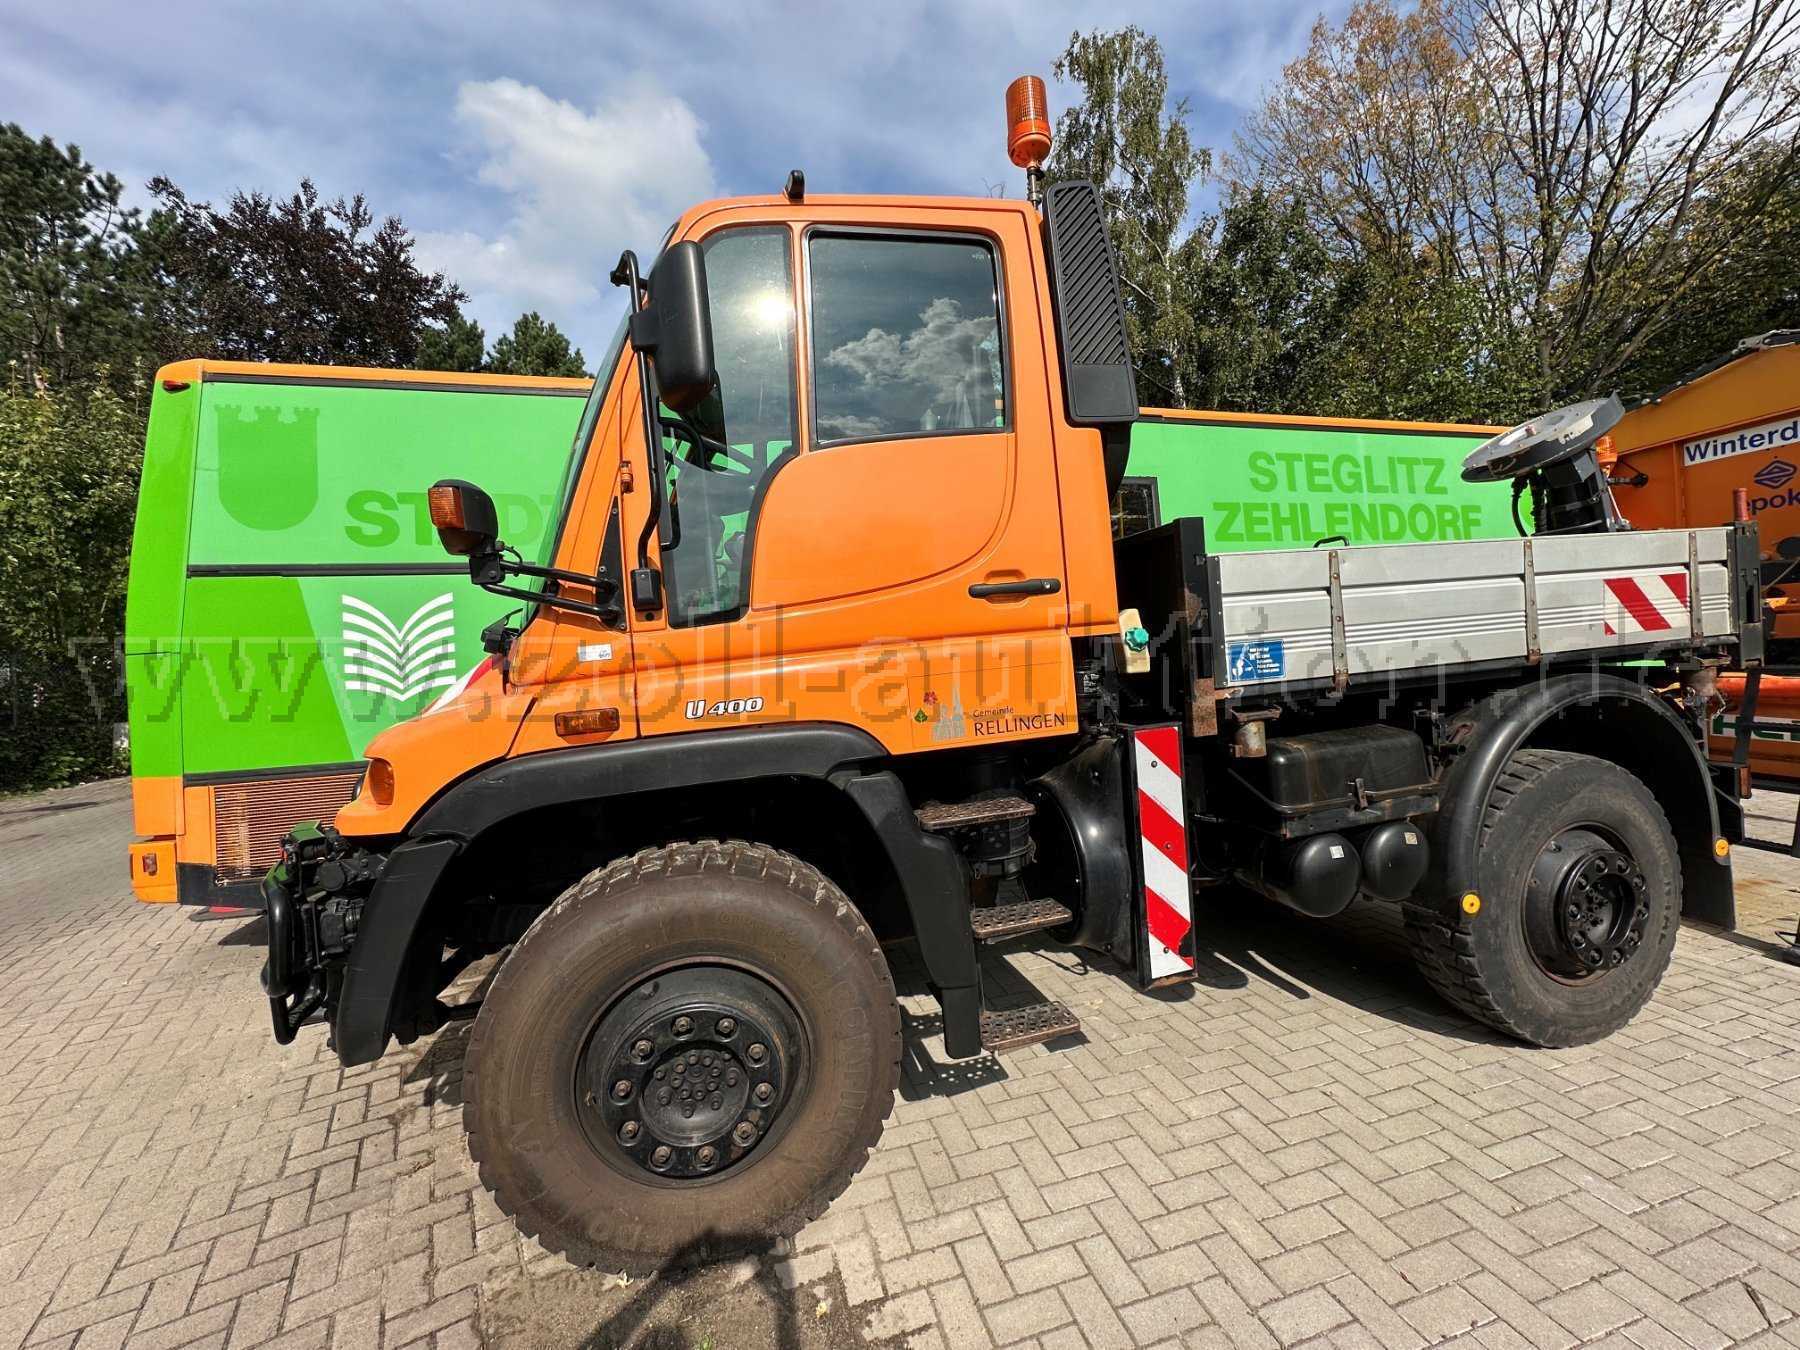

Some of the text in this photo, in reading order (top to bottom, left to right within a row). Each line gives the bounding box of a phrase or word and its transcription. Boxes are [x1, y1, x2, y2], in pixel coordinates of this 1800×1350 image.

[1685, 420, 1799, 462] Winterd
[1248, 451, 1448, 495] STEGLITZ
[1746, 488, 1800, 515] pok
[344, 489, 556, 548] STD
[1212, 502, 1482, 542] ZEHLENDORF
[685, 697, 764, 719] U 400
[972, 705, 1014, 718] Gemeinde
[974, 712, 1066, 736] RELLINGEN
